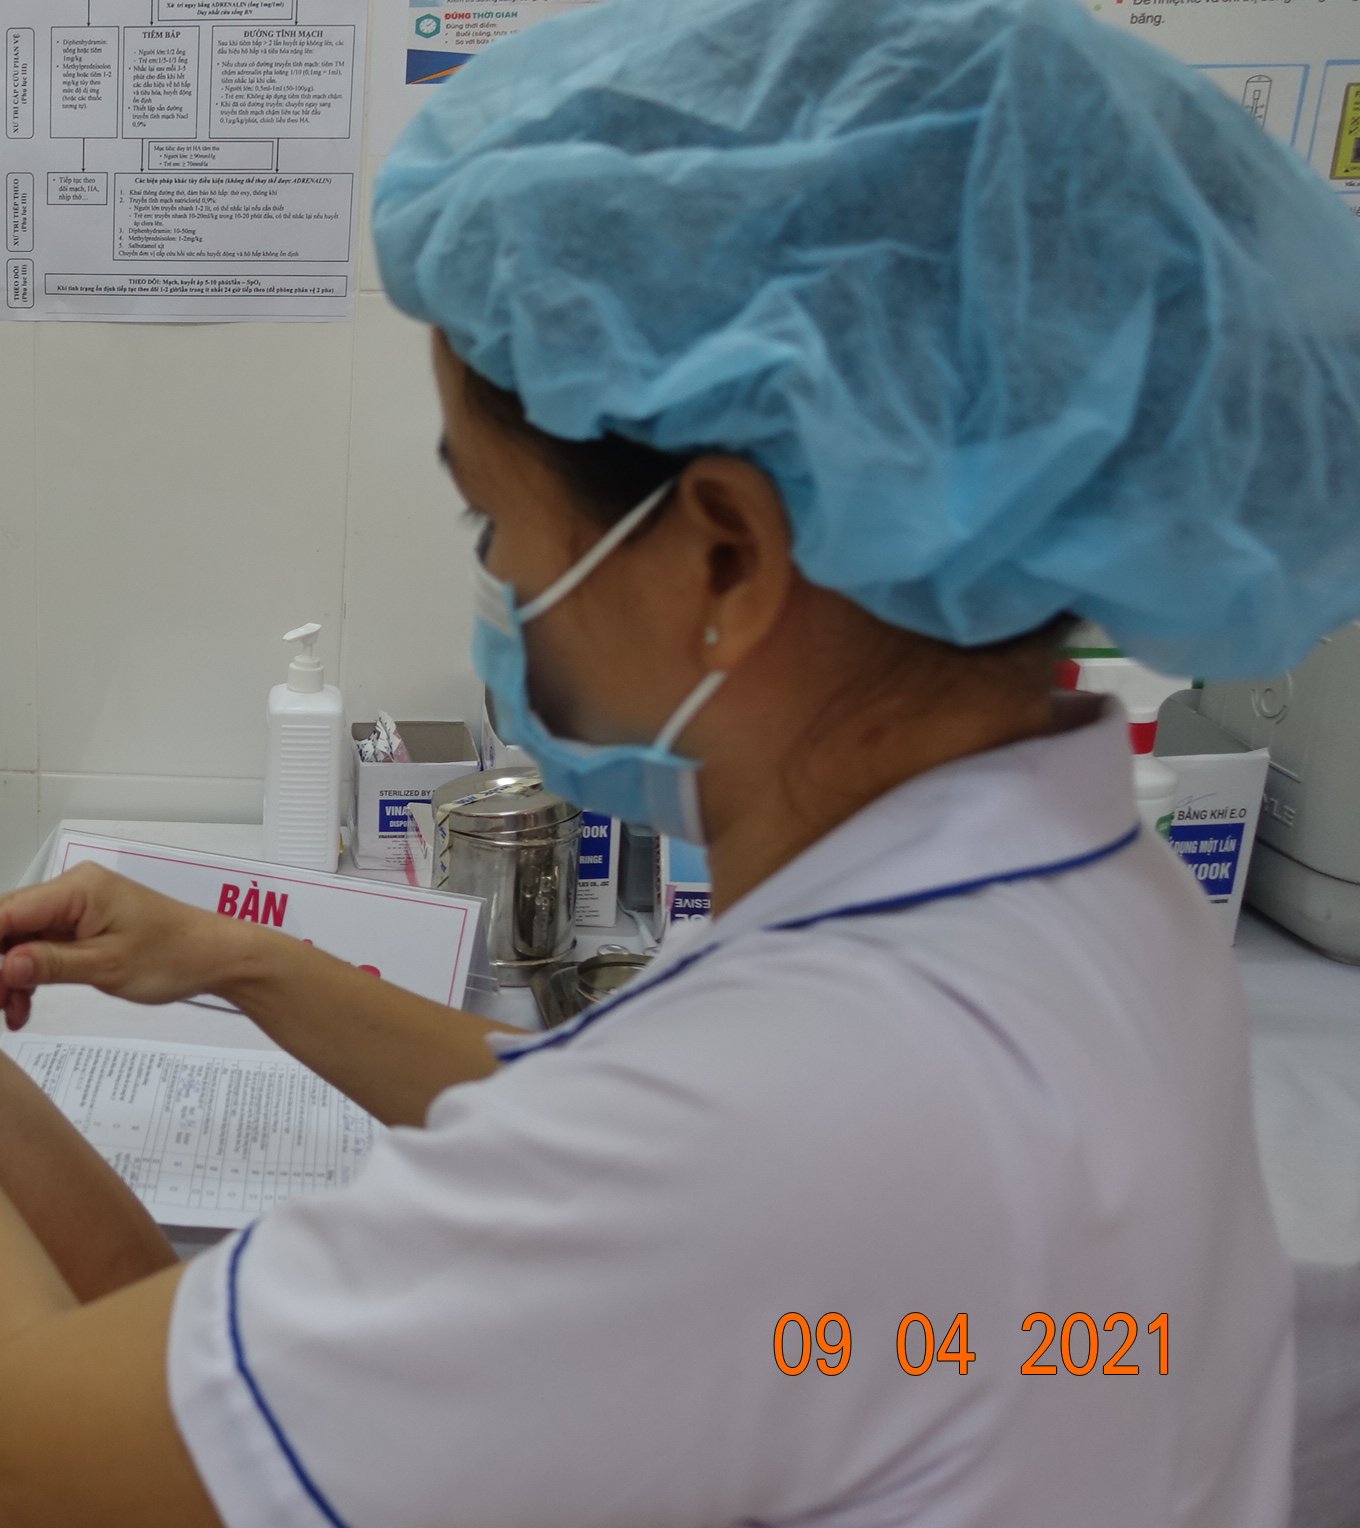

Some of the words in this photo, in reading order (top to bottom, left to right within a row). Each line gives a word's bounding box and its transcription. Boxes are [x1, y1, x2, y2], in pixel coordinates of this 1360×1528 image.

[444, 11, 471, 20] ĐÚNG
[473, 11, 494, 19] THỜI
[1130, 13, 1165, 26] băng.
[12, 179, 21, 202] THEO
[1177, 808, 1208, 821] BẰNG
[1229, 808, 1247, 819] E.O
[580, 825, 608, 838] OOK
[216, 880, 288, 928] BÀN
